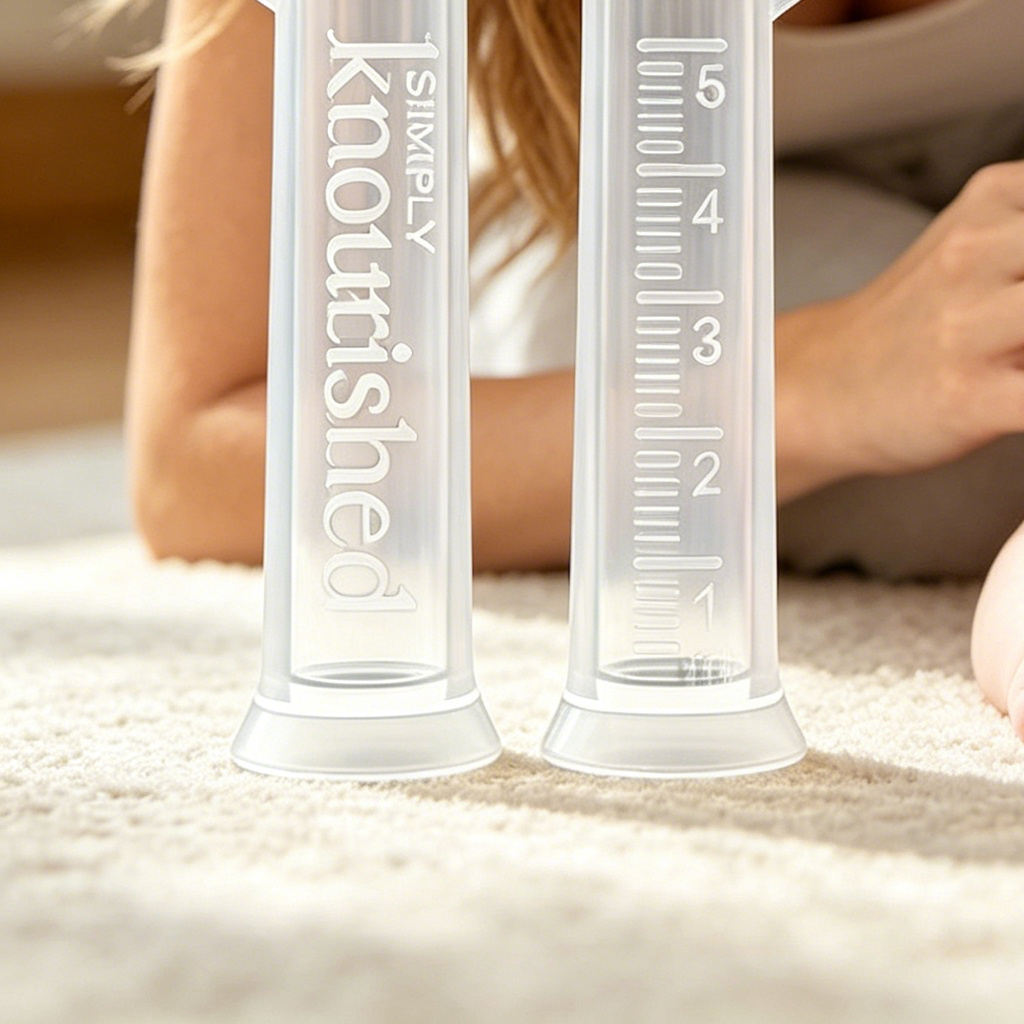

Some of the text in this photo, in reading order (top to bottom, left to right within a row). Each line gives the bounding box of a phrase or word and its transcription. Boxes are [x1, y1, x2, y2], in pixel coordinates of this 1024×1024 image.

[695, 63, 726, 109] 5
[692, 188, 725, 234] 4
[323, 28, 440, 613] knourished
[692, 316, 722, 366] 3
[692, 451, 722, 497] 2
[693, 581, 715, 633] 1
